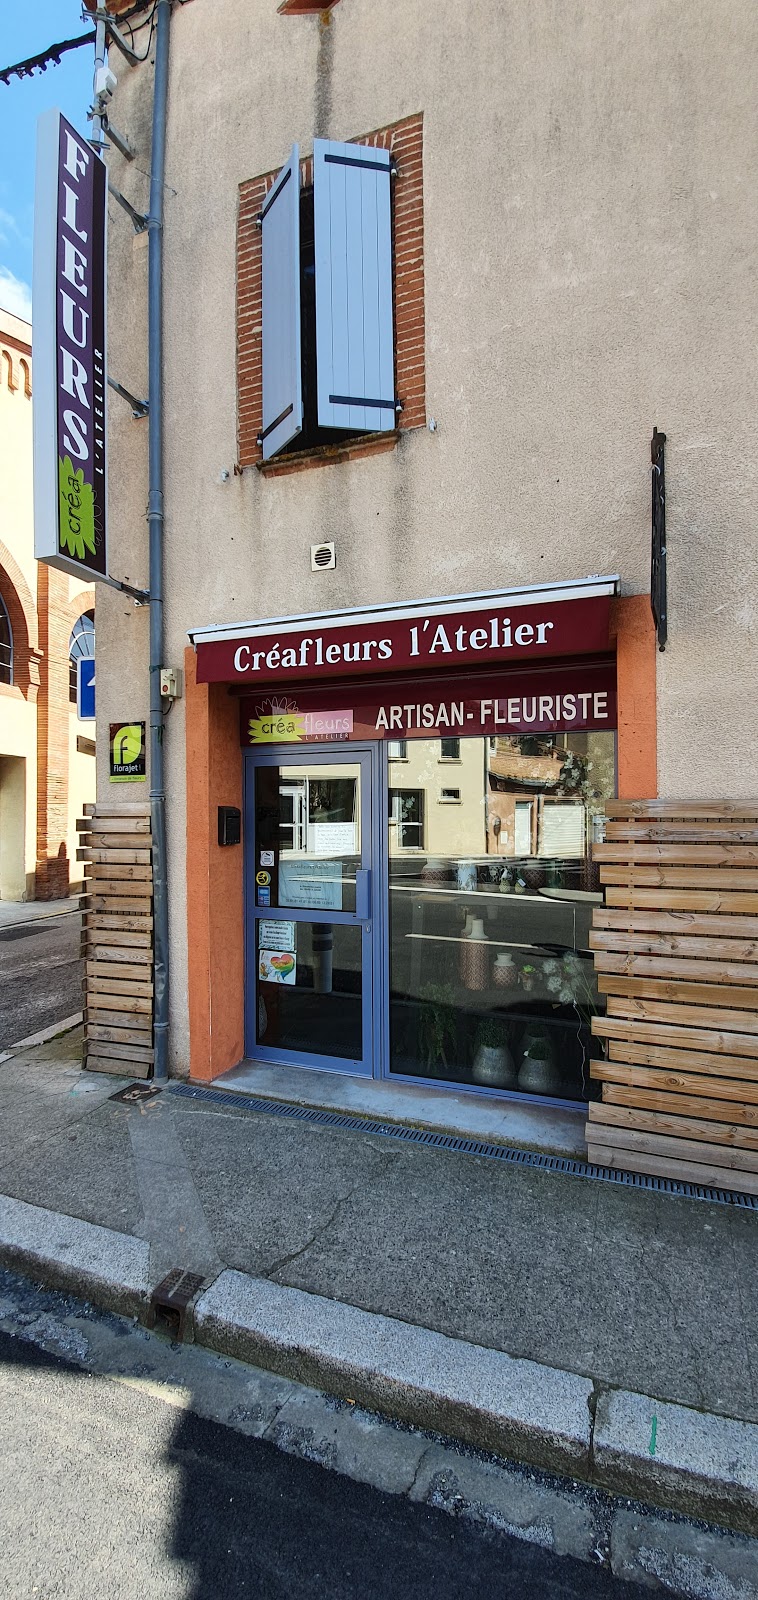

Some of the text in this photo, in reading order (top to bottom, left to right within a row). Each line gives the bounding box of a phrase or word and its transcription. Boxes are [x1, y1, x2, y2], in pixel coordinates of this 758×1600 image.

[60, 129, 91, 462] FLEURS
[94, 347, 104, 477] L'ATELIER
[65, 472, 85, 536] créa
[233, 617, 555, 673] Créafleurs l'Atelier
[261, 713, 350, 735] créa fleurs
[480, 691, 609, 725] FLEURISTE
[305, 732, 350, 741] L'ATELIER
[113, 764, 139, 774] florajet
